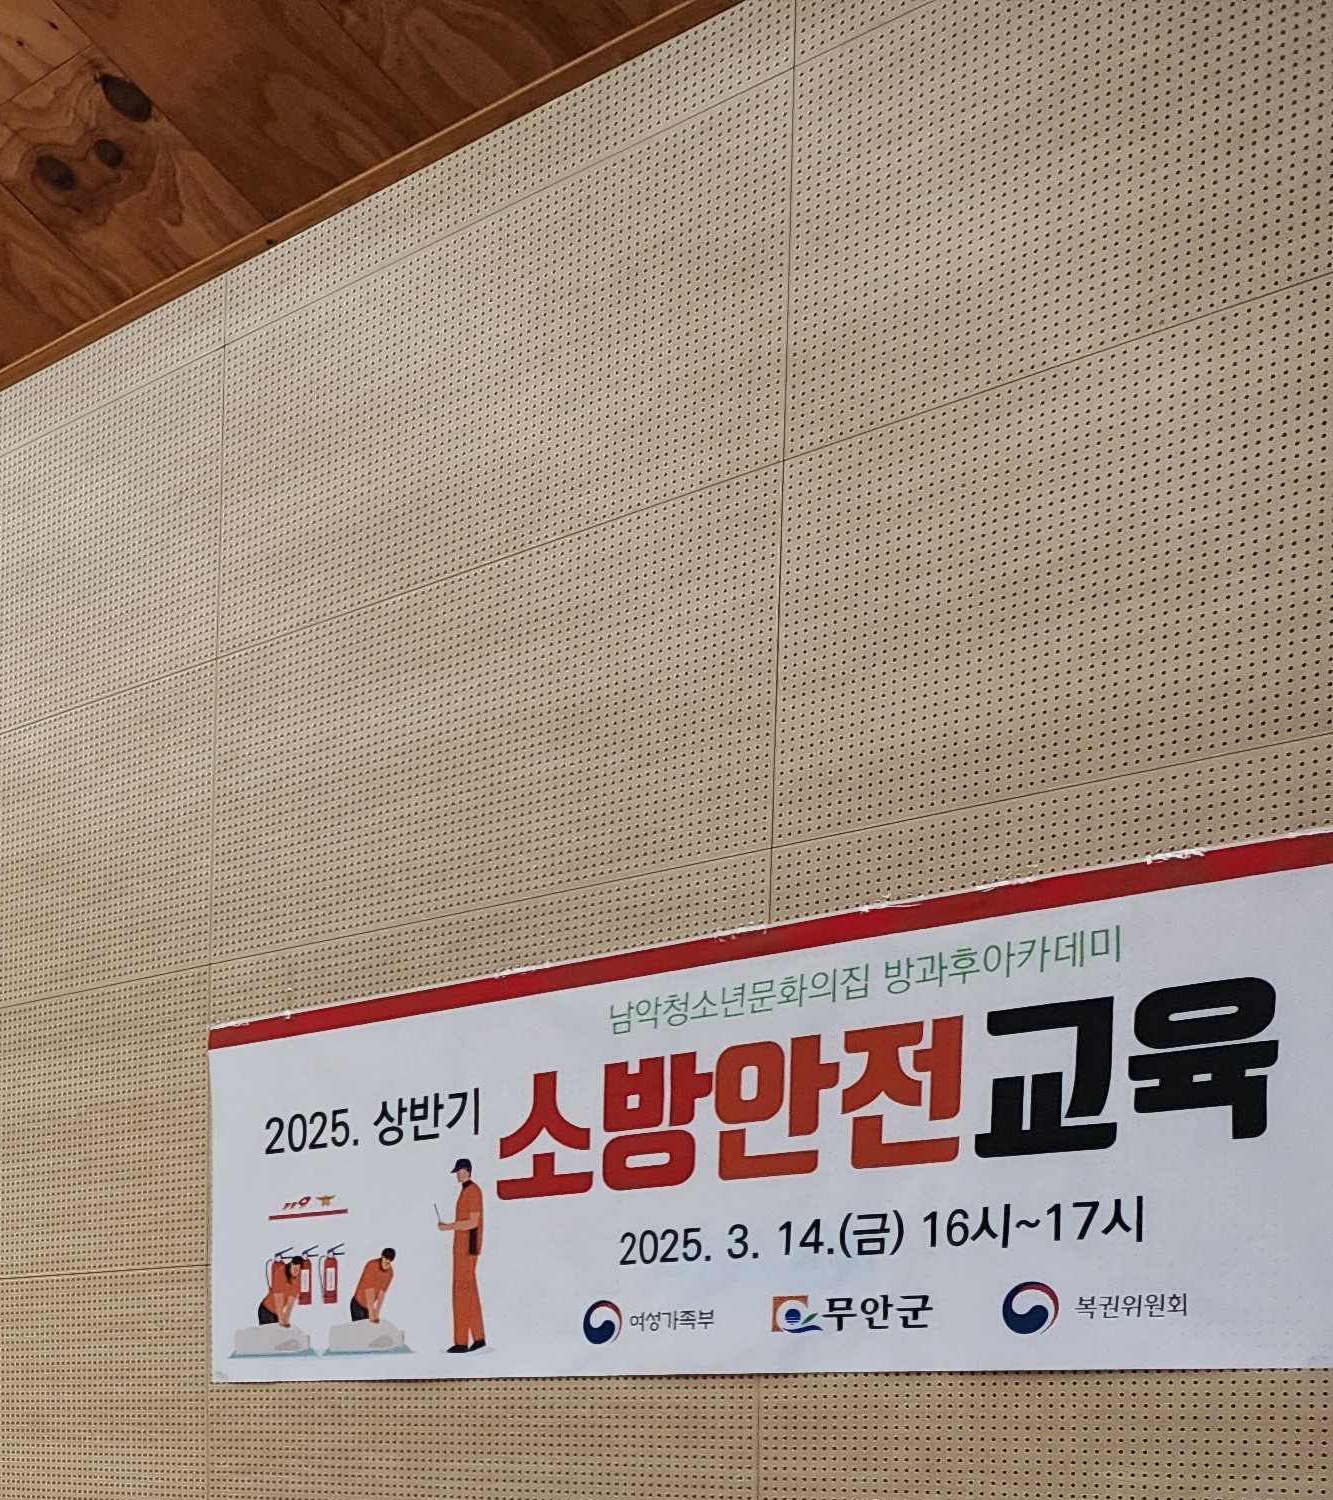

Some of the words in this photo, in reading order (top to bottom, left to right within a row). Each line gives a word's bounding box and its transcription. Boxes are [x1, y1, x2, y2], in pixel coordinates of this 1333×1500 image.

[609, 964, 870, 1036] 남악청소년문화의집
[884, 924, 1124, 987] 방과후아카데미
[265, 1108, 359, 1155] 2025.
[373, 1087, 480, 1147] 상반기
[496, 976, 1280, 1201] 소방안전교육
[619, 1227, 712, 1266] 2025.
[727, 1223, 759, 1260] 3.
[778, 1209, 905, 1259] 14.(금)
[923, 1195, 1144, 1249] 16시~17시
[629, 1309, 715, 1332] 여성가족부
[821, 1294, 934, 1332] 무안군
[1074, 1292, 1188, 1320] 복권위원회
